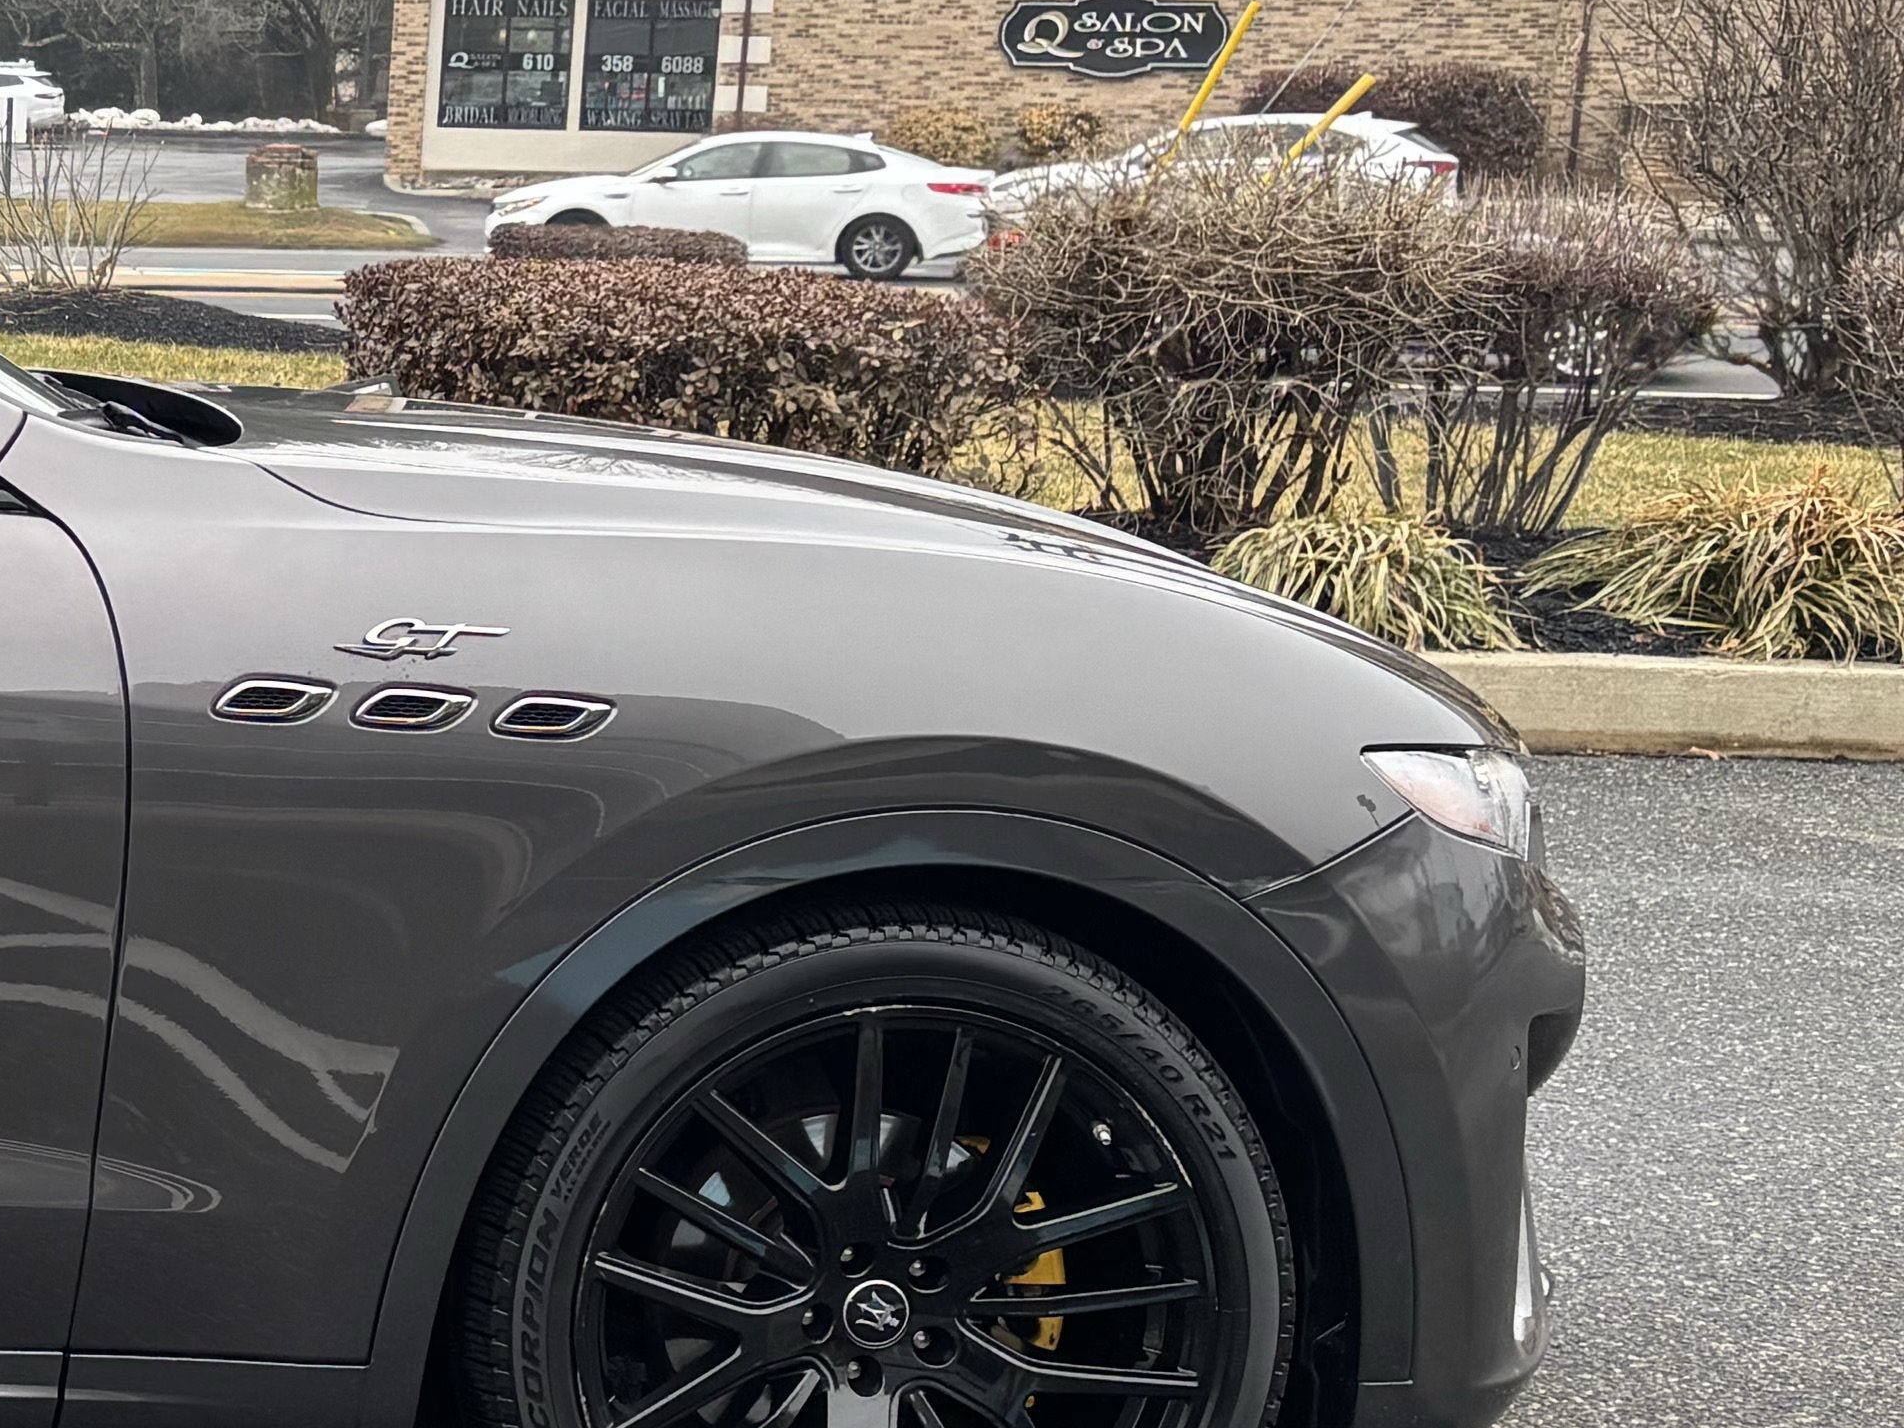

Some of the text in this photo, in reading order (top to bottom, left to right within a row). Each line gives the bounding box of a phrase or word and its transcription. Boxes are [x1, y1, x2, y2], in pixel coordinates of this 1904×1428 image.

[516, 0, 569, 16] NAILS
[594, 0, 649, 18] FACIAL
[1017, 10, 1207, 59] Q SALON
[1105, 36, 1188, 58] SPA
[522, 53, 554, 71] 610
[601, 54, 633, 72] 358
[661, 56, 704, 74] 6088
[442, 105, 498, 125] BRIDAL
[333, 617, 512, 660] GT
[1040, 984, 1238, 1160] 265/40 R21
[550, 1110, 603, 1199] VERDE
